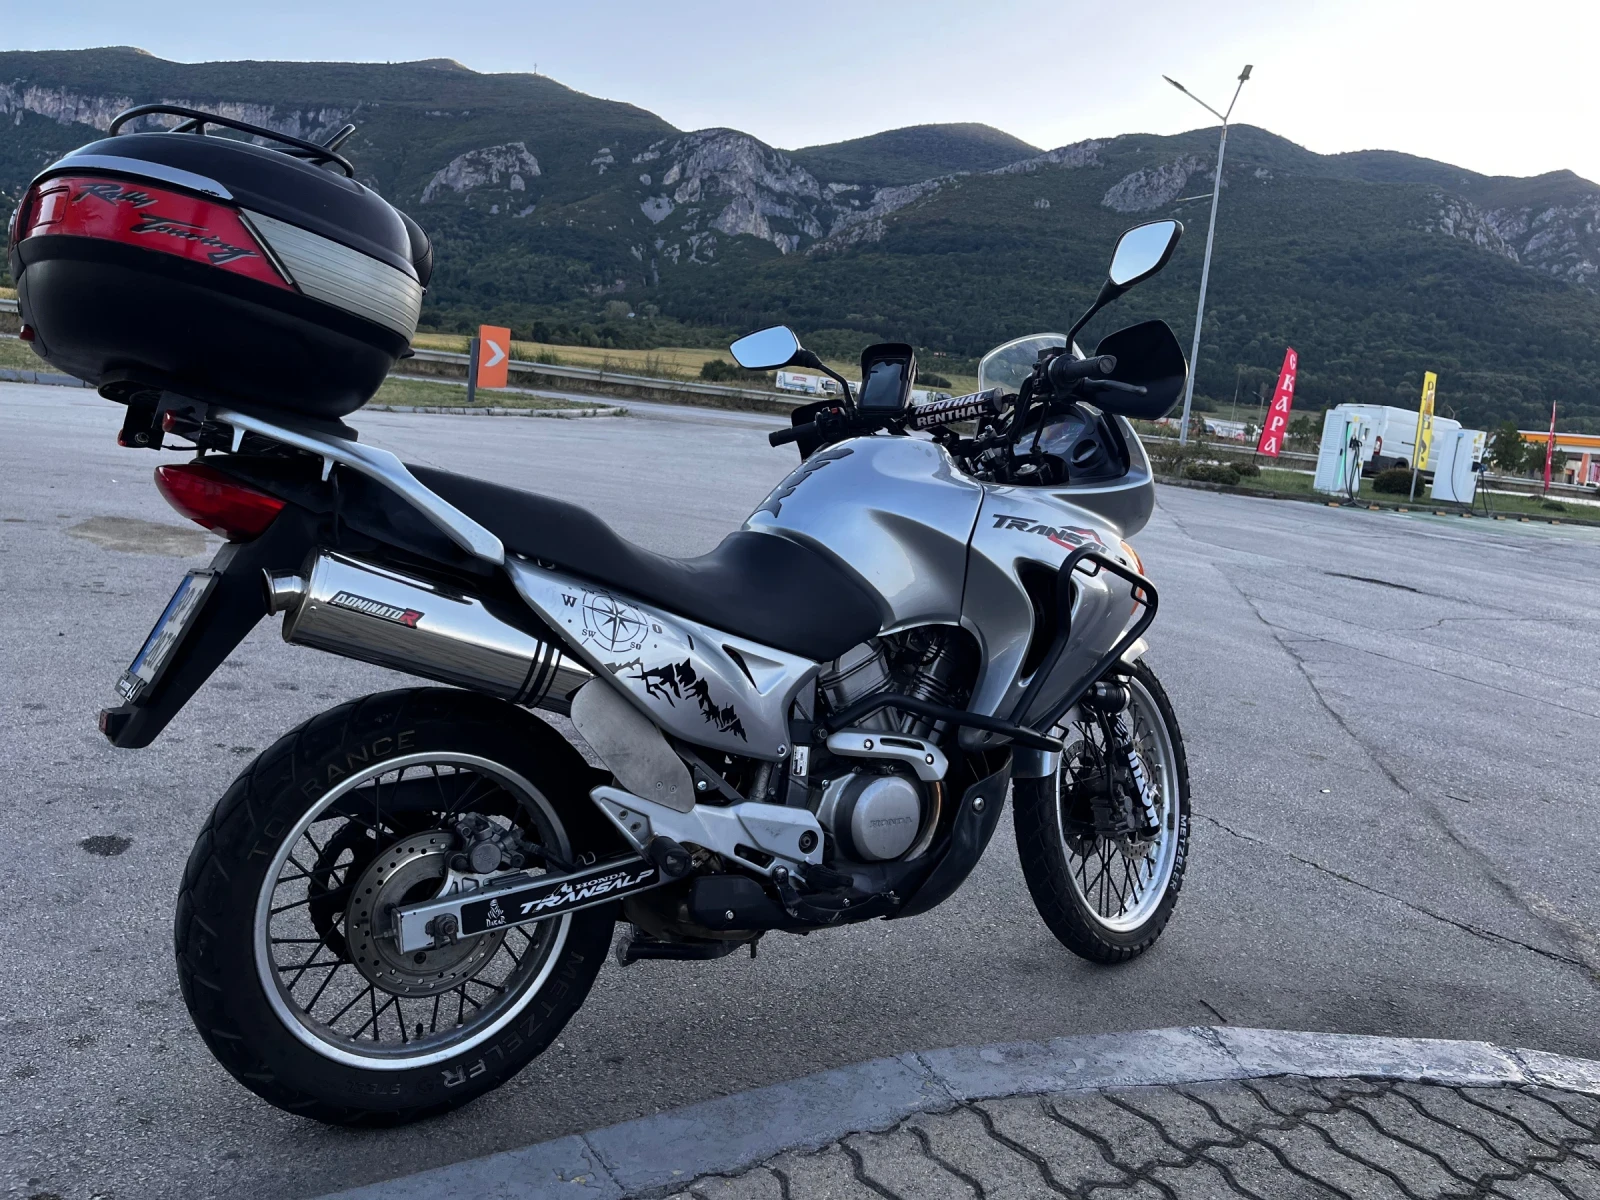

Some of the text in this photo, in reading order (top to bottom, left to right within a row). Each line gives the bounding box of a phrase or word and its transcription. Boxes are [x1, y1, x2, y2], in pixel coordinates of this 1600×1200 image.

[72, 183, 158, 208] Rally
[131, 213, 260, 265] Touring
[915, 393, 986, 415] RENTHAL
[916, 404, 988, 427] RENTHAL
[1264, 353, 1297, 454] СКАРА
[334, 593, 420, 627] DOMINATOR
[561, 594, 577, 607] W
[581, 628, 596, 638] SW
[869, 816, 913, 828] HONDA
[1170, 814, 1187, 890] METZELER
[520, 869, 655, 915] TRANSALP
[575, 871, 628, 890] HONDA
[441, 950, 585, 1089] METZELER
